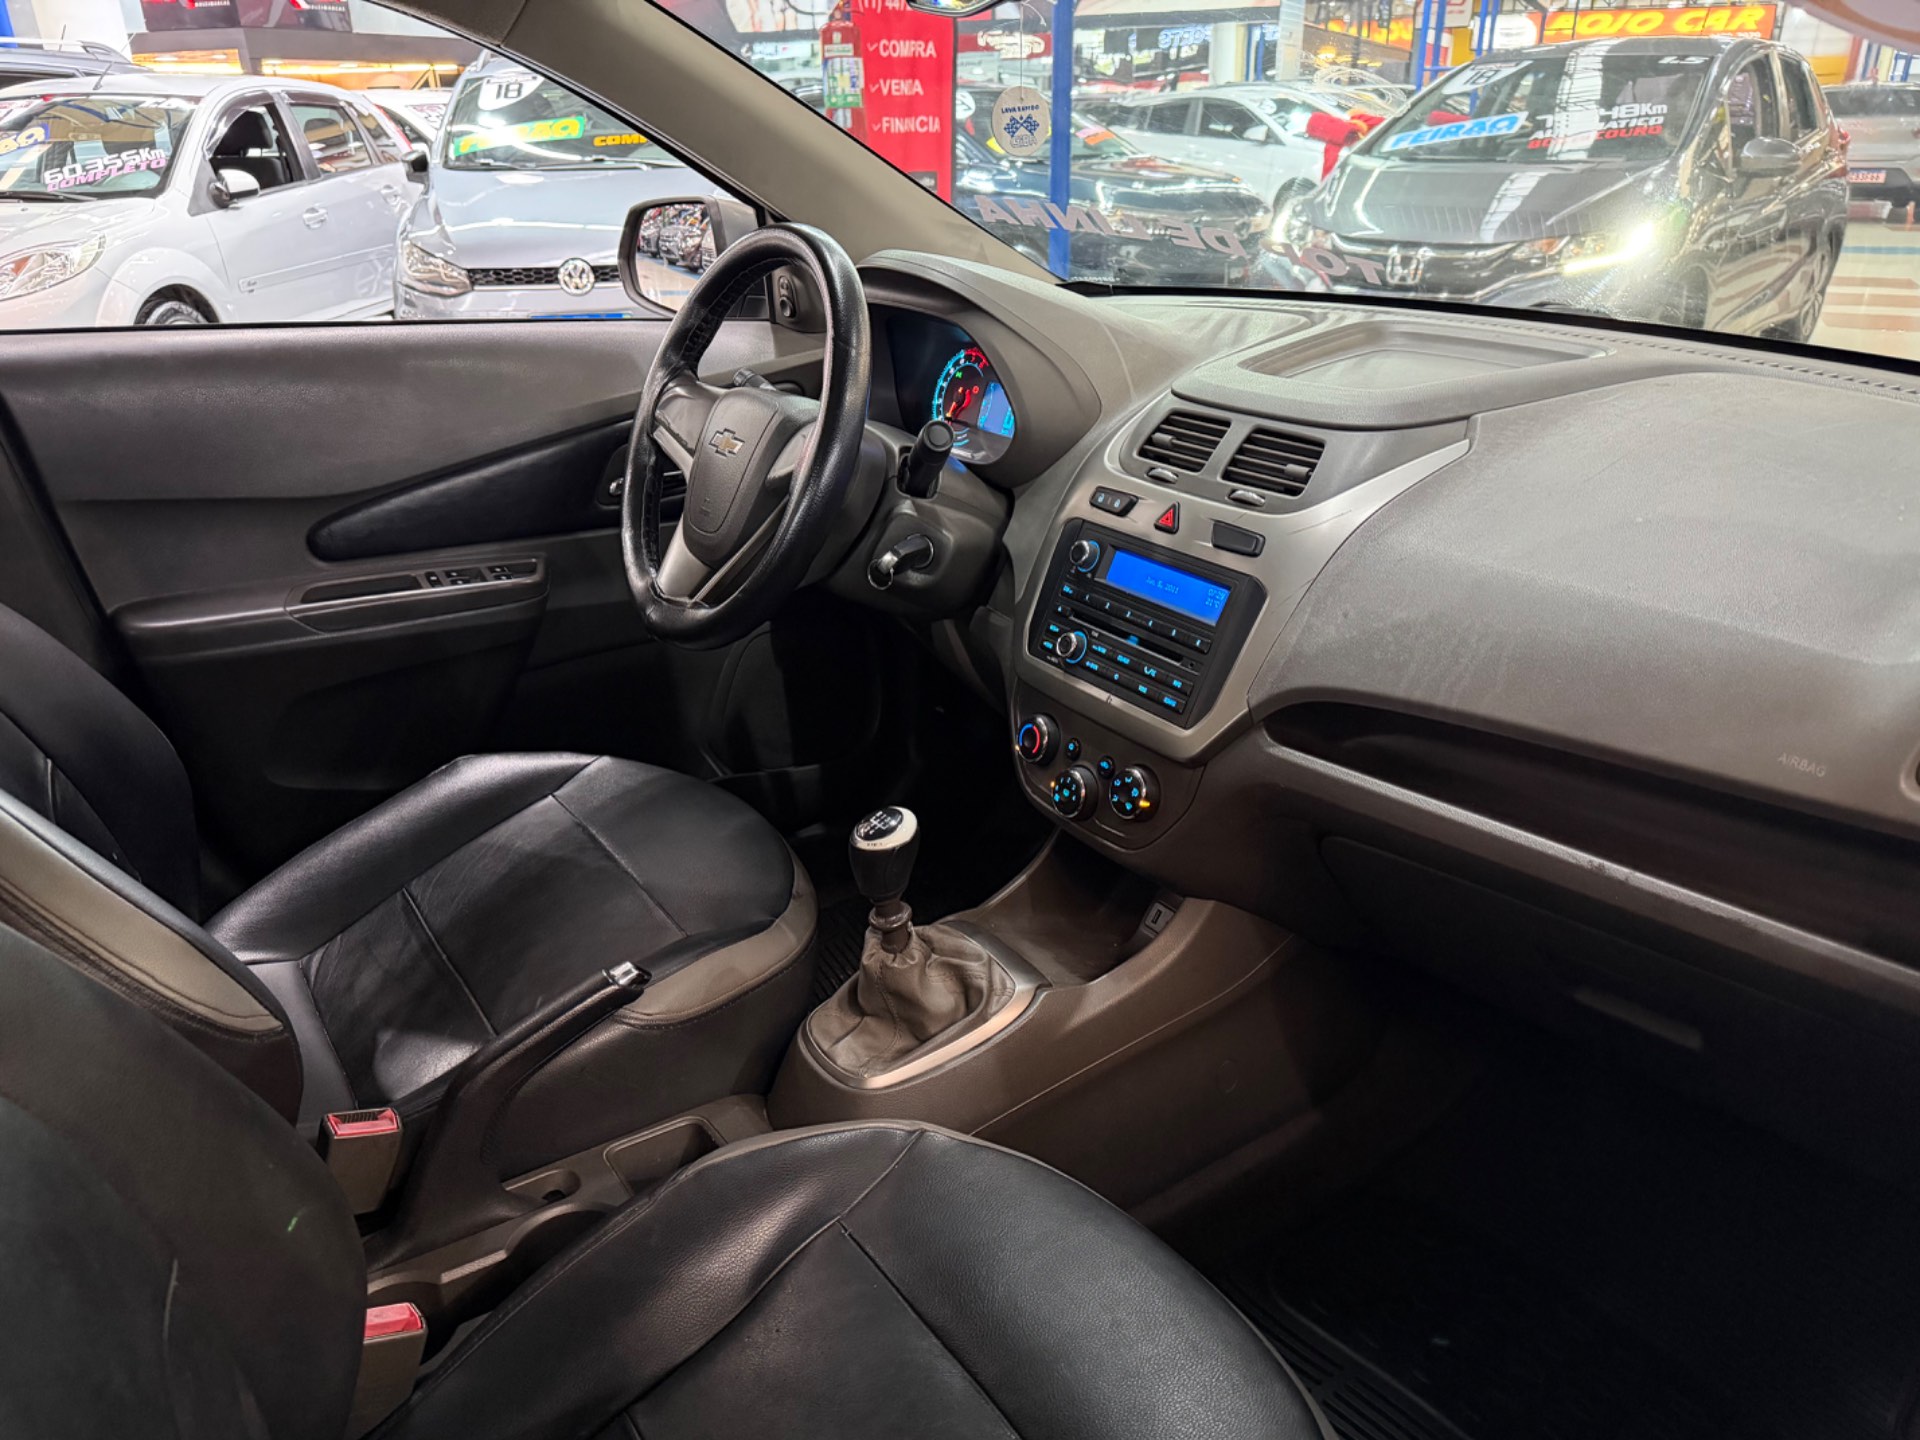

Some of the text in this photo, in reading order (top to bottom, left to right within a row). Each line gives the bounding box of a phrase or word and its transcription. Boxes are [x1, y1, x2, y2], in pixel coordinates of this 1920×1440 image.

[1674, 8, 1766, 33] CAR
[1464, 70, 1501, 86] 18
[496, 82, 523, 100] 18
[47, 159, 169, 192] COMPLETO
[1777, 752, 1827, 778] AIRBAG
